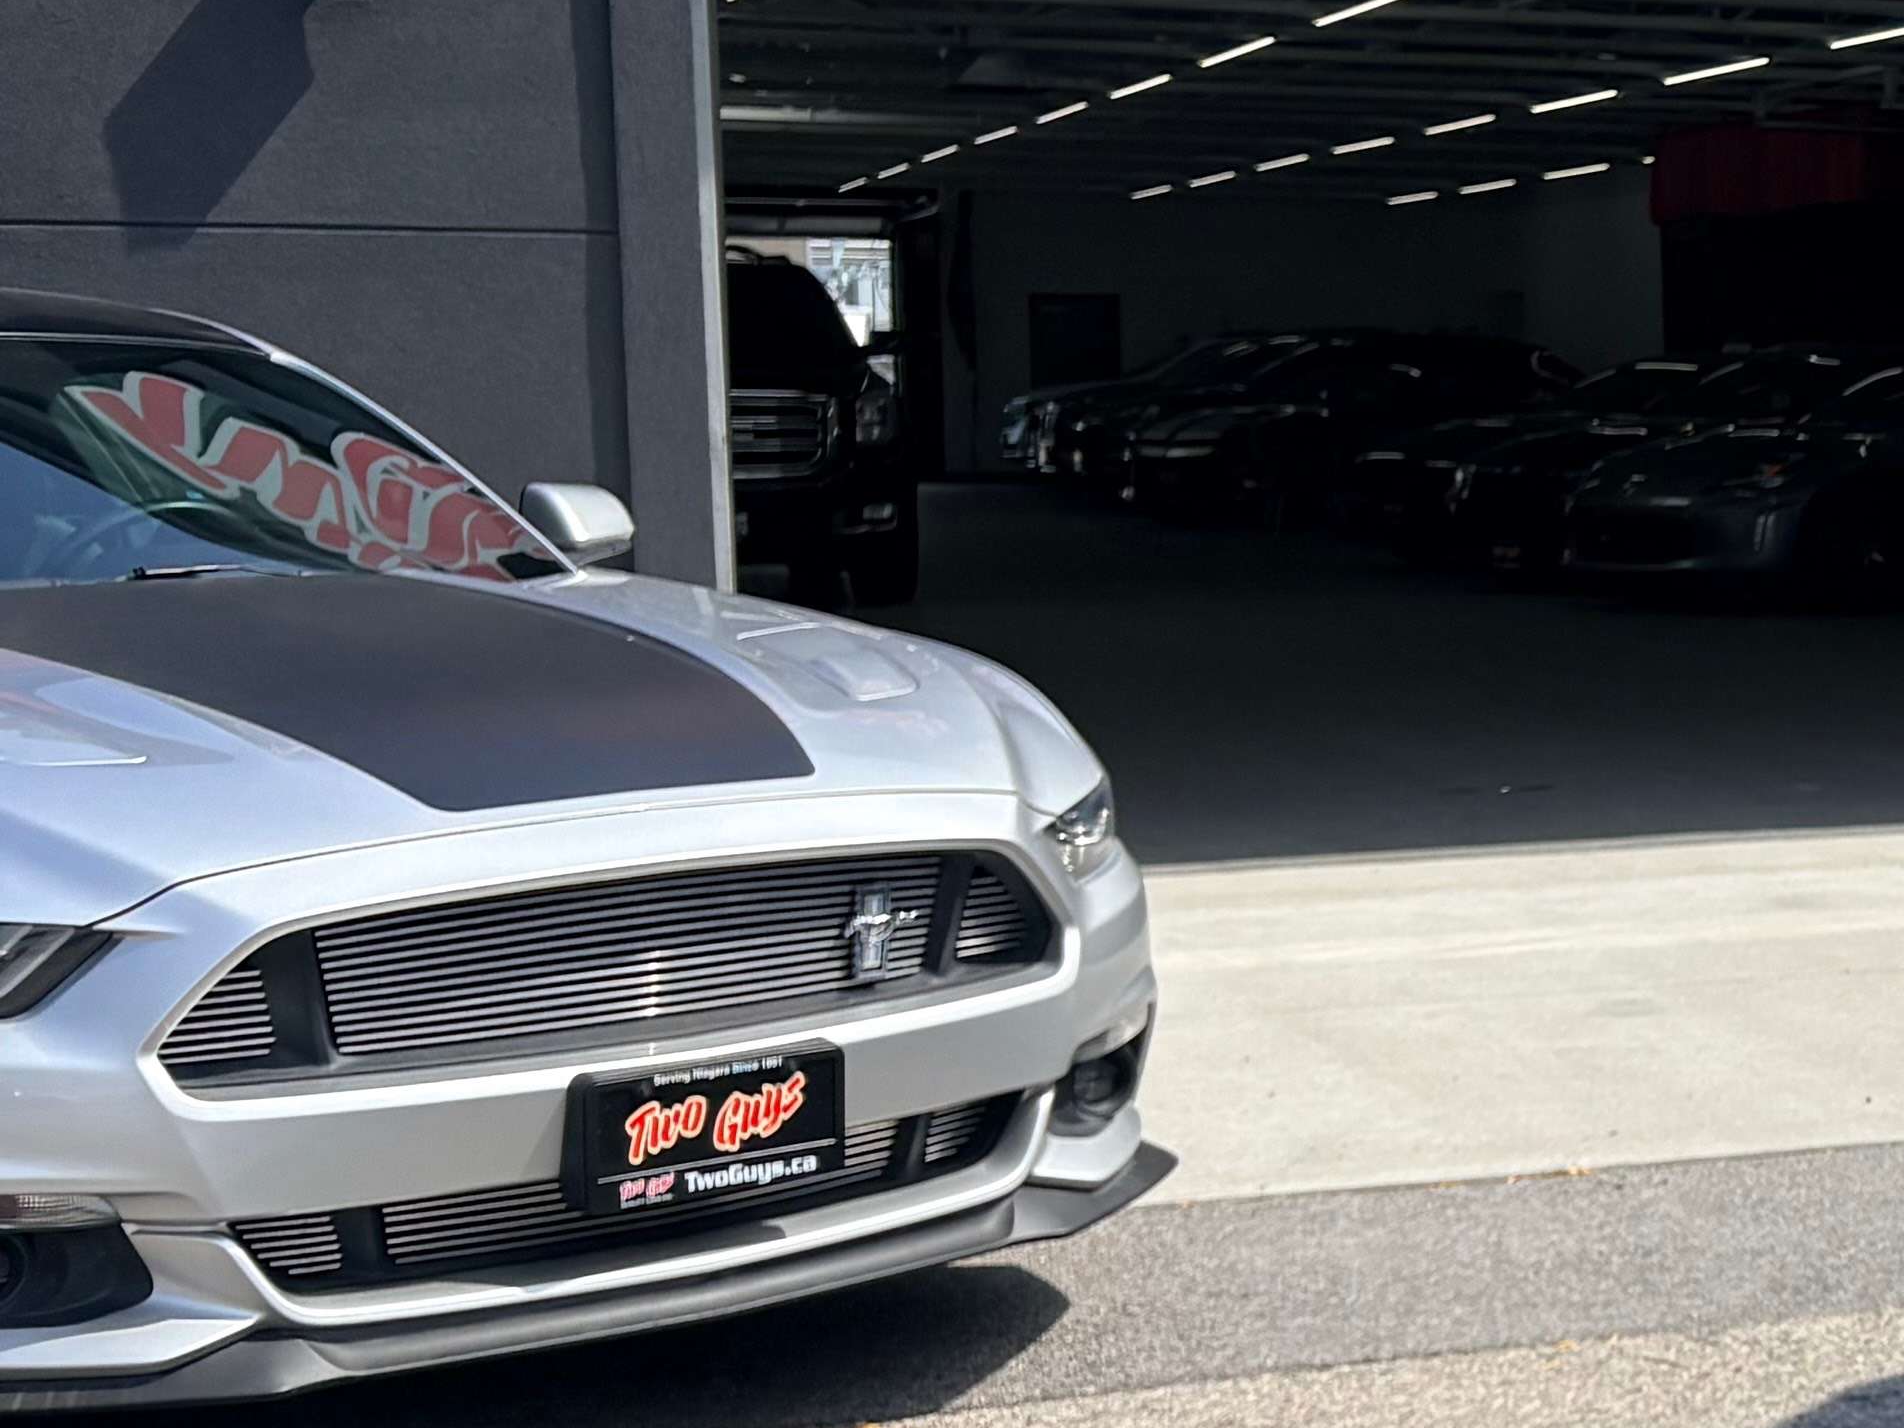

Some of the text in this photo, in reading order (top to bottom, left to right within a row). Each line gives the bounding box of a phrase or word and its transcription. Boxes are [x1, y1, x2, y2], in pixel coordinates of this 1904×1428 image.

[624, 1070, 806, 1165] Two Guys
[684, 1155, 817, 1193] TwoGuys.ca
